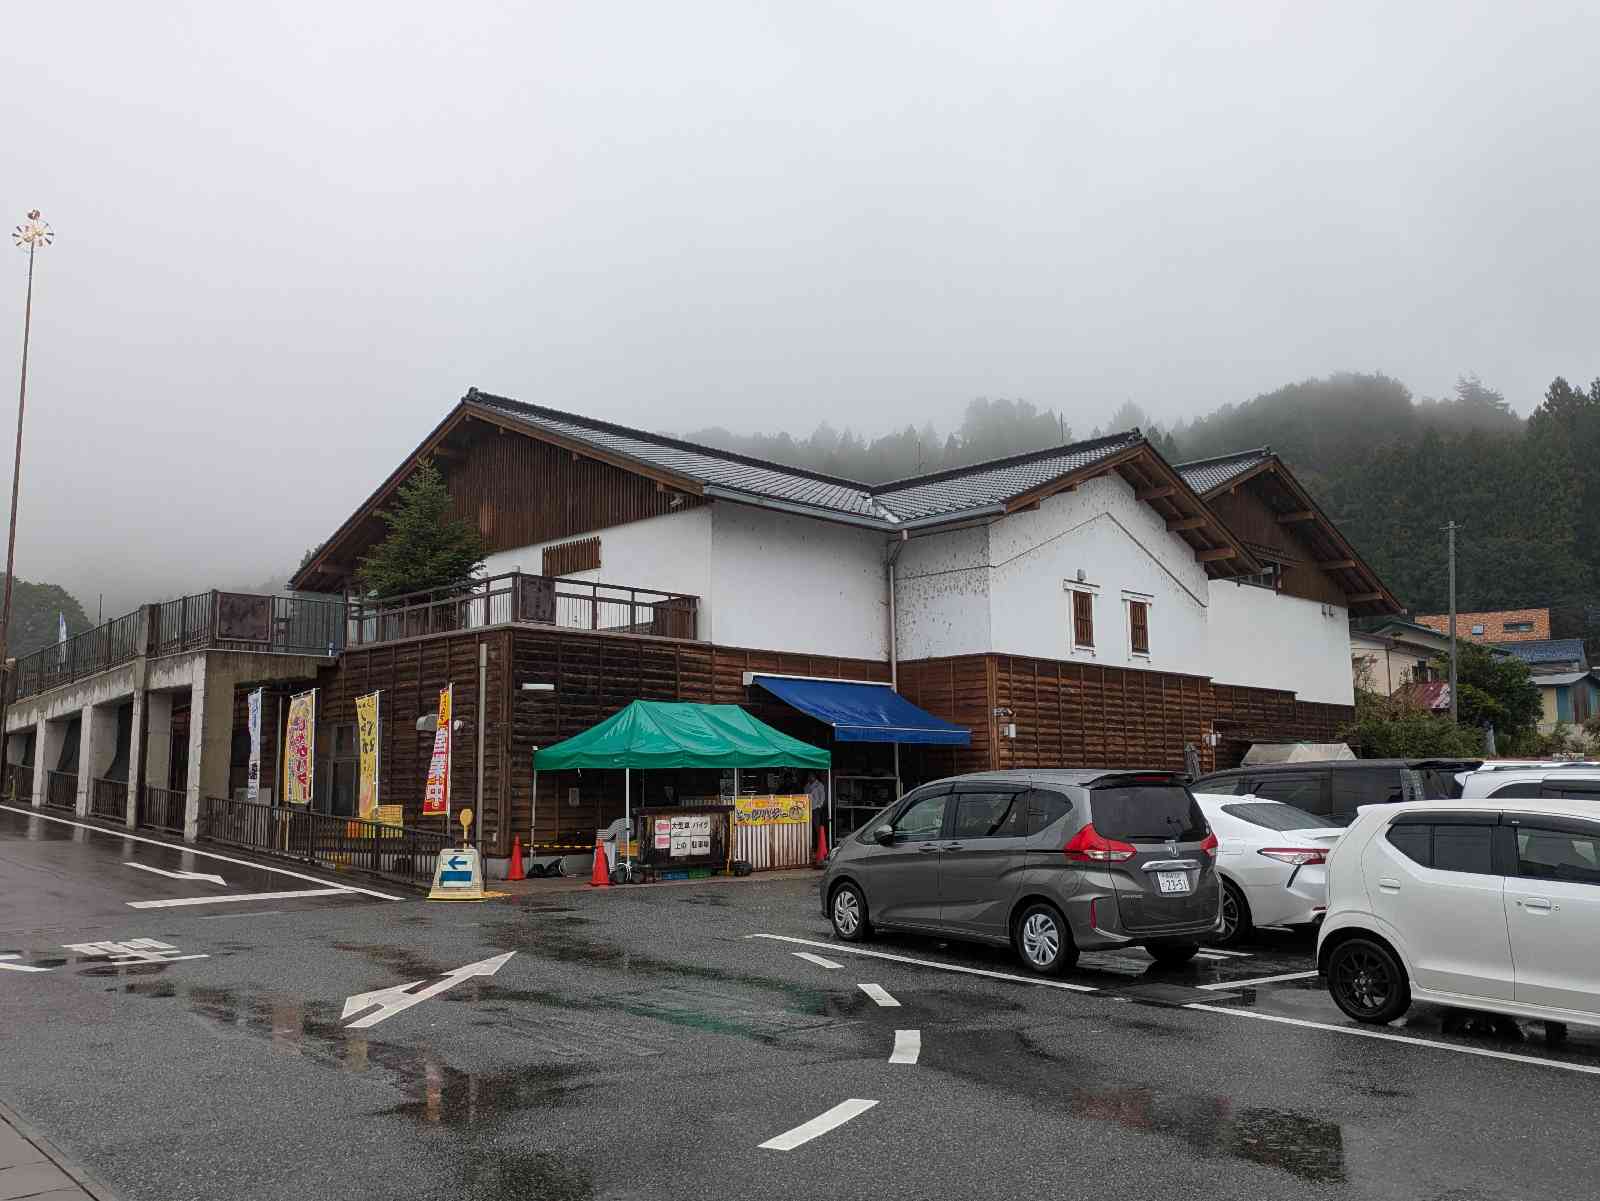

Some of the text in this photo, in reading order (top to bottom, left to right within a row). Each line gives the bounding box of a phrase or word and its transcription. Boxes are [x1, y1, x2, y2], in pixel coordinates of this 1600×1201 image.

[672, 821, 709, 830] 大型車 バイク
